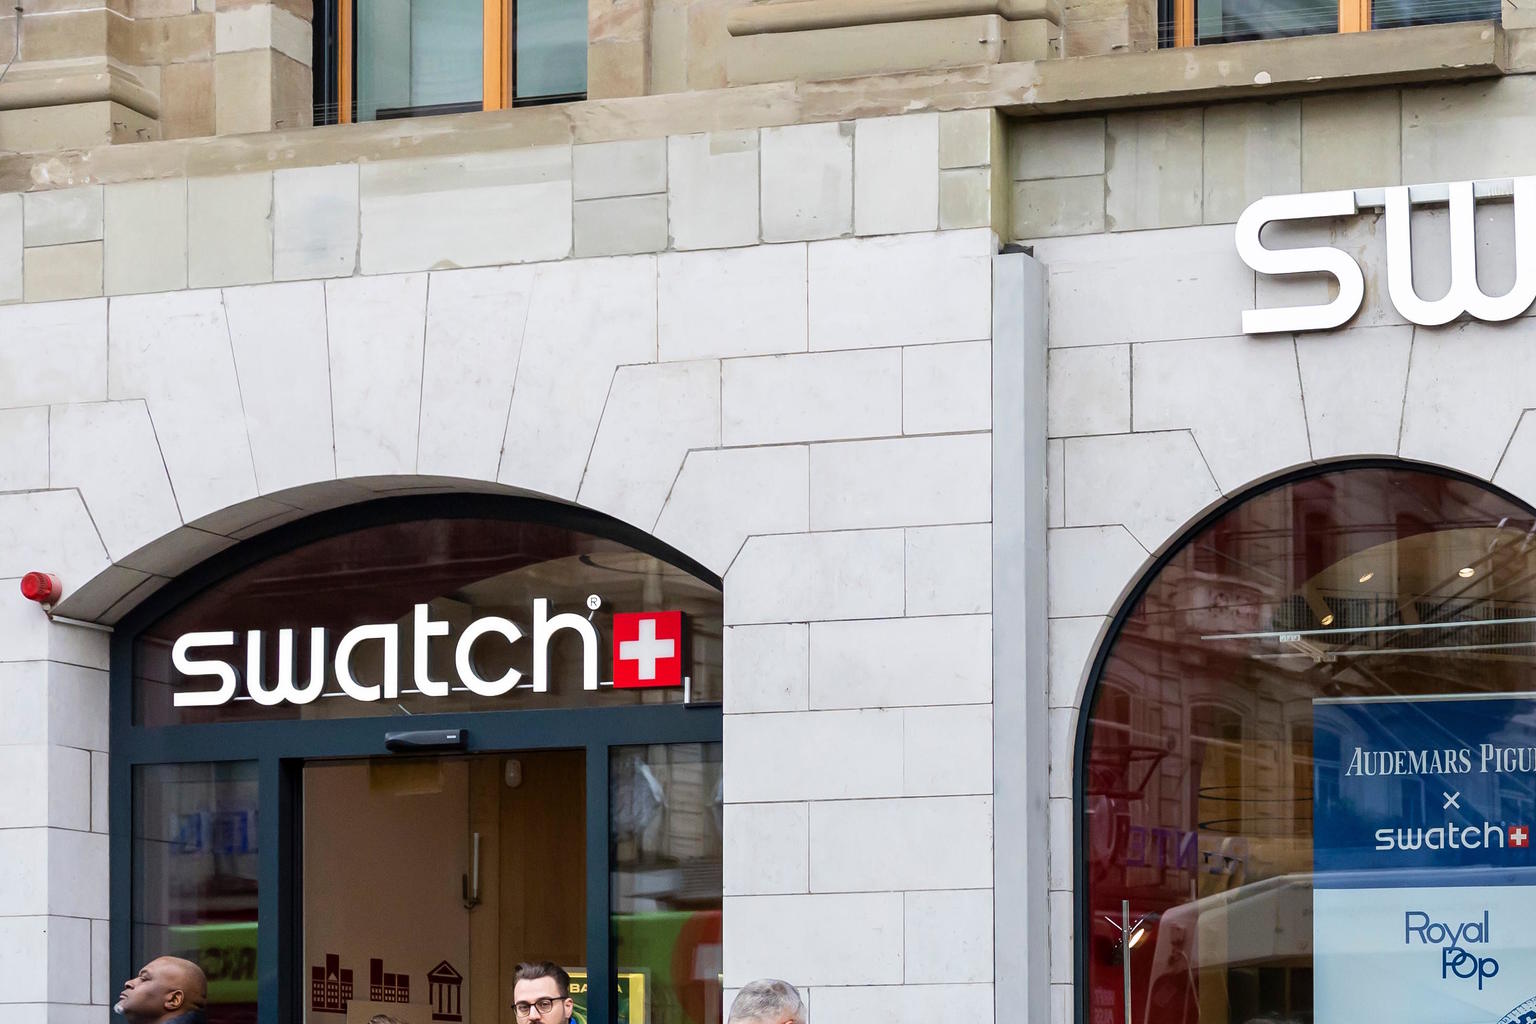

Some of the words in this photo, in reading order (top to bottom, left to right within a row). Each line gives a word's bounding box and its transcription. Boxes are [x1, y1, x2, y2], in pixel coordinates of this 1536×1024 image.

[172, 597, 599, 707] swatch
[1345, 747, 1472, 777] AUDEMARS
[1374, 821, 1504, 851] swatch
[1404, 910, 1489, 951] Royal
[1441, 948, 1499, 990] Pop
